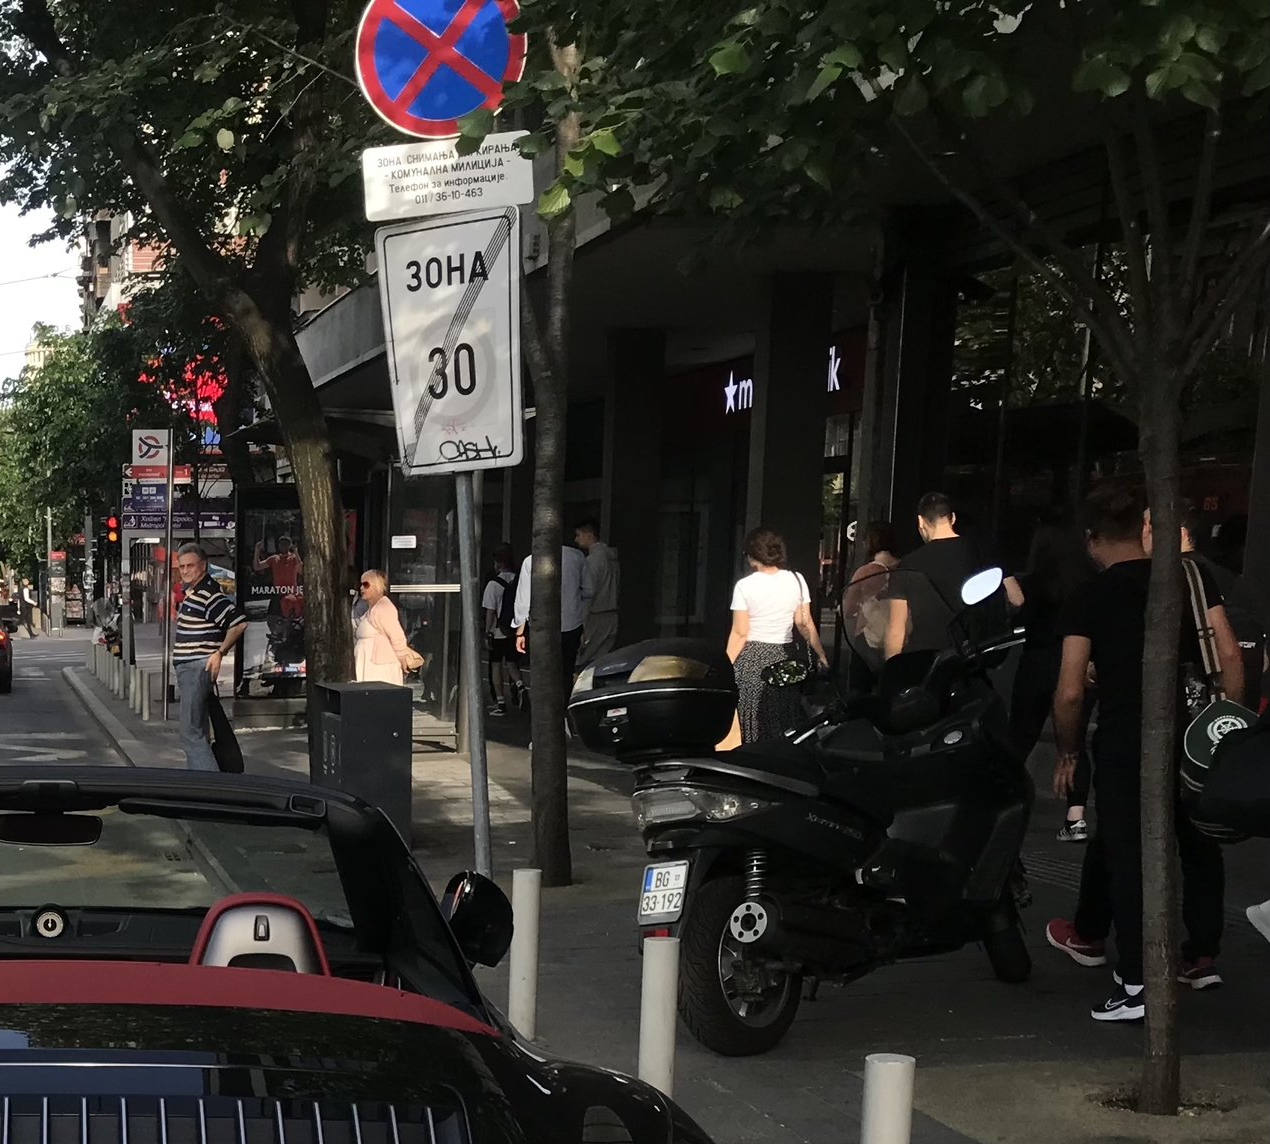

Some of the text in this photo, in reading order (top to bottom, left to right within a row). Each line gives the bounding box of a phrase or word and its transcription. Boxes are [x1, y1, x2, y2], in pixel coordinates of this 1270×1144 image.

[391, 164, 449, 180] КОМУНАЛНА
[451, 158, 504, 173] МИЛИЦИЈА
[389, 180, 429, 194] Телефон
[431, 181, 442, 190] за
[405, 250, 489, 292] ЗОНА
[427, 342, 476, 400] 30
[251, 585, 294, 595] MARATON
[655, 870, 670, 888] BG
